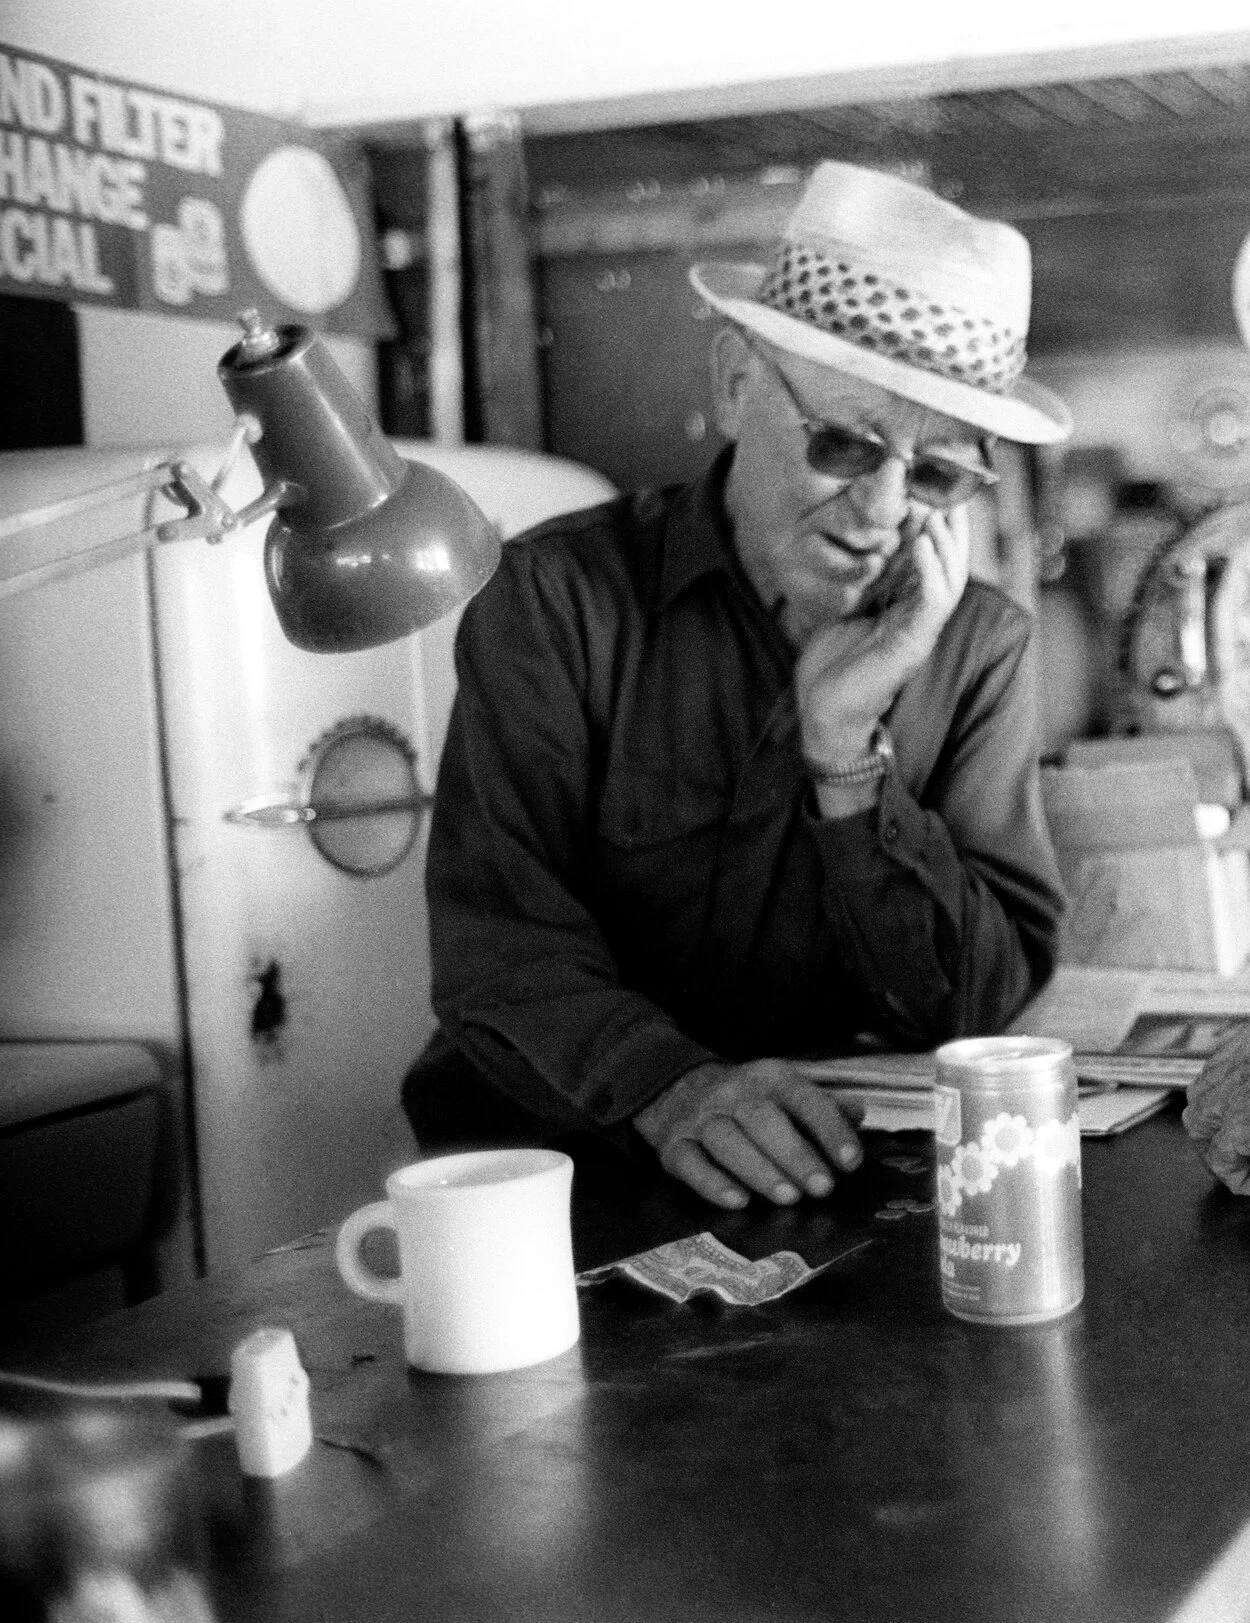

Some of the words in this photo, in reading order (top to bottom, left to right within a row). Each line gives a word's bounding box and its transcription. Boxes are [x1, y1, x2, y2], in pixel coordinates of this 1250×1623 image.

[70, 74, 224, 176] FILTER
[0, 131, 148, 231] HANGE
[0, 208, 114, 294] CIAL
